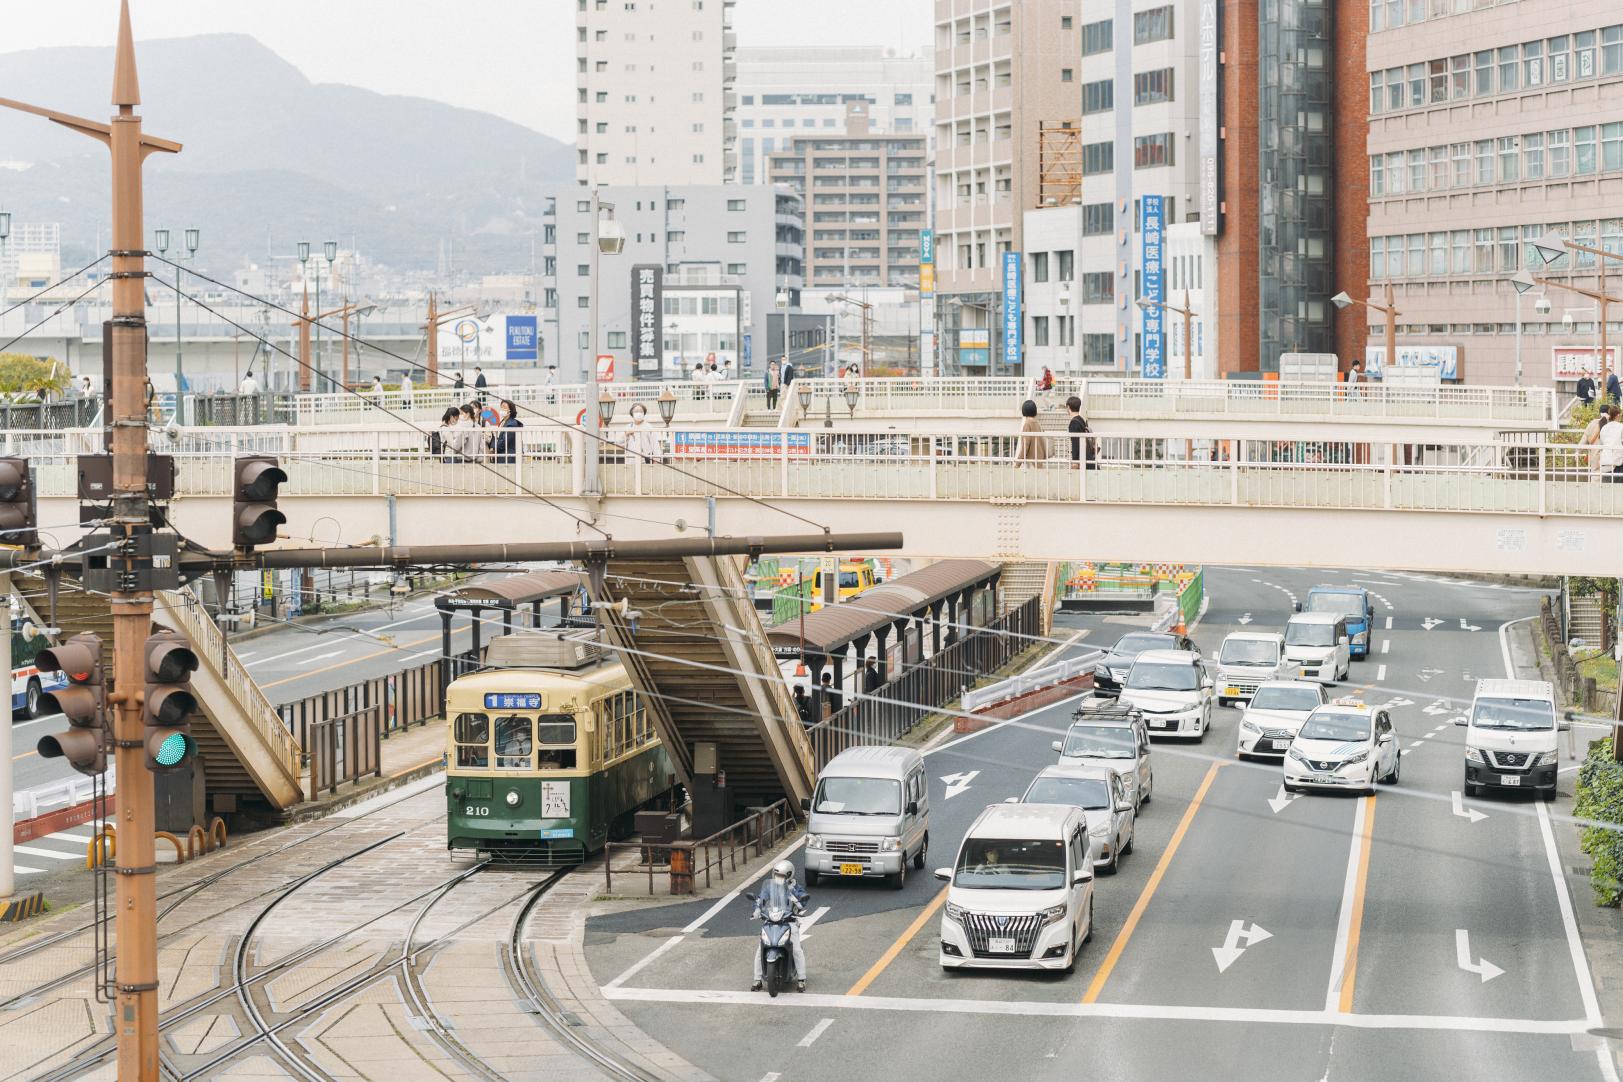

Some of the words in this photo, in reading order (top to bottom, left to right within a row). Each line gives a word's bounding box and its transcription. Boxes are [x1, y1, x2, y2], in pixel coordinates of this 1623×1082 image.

[639, 268, 655, 357] 売買物件募集
[487, 694, 498, 708] 1
[465, 806, 489, 816] 210
